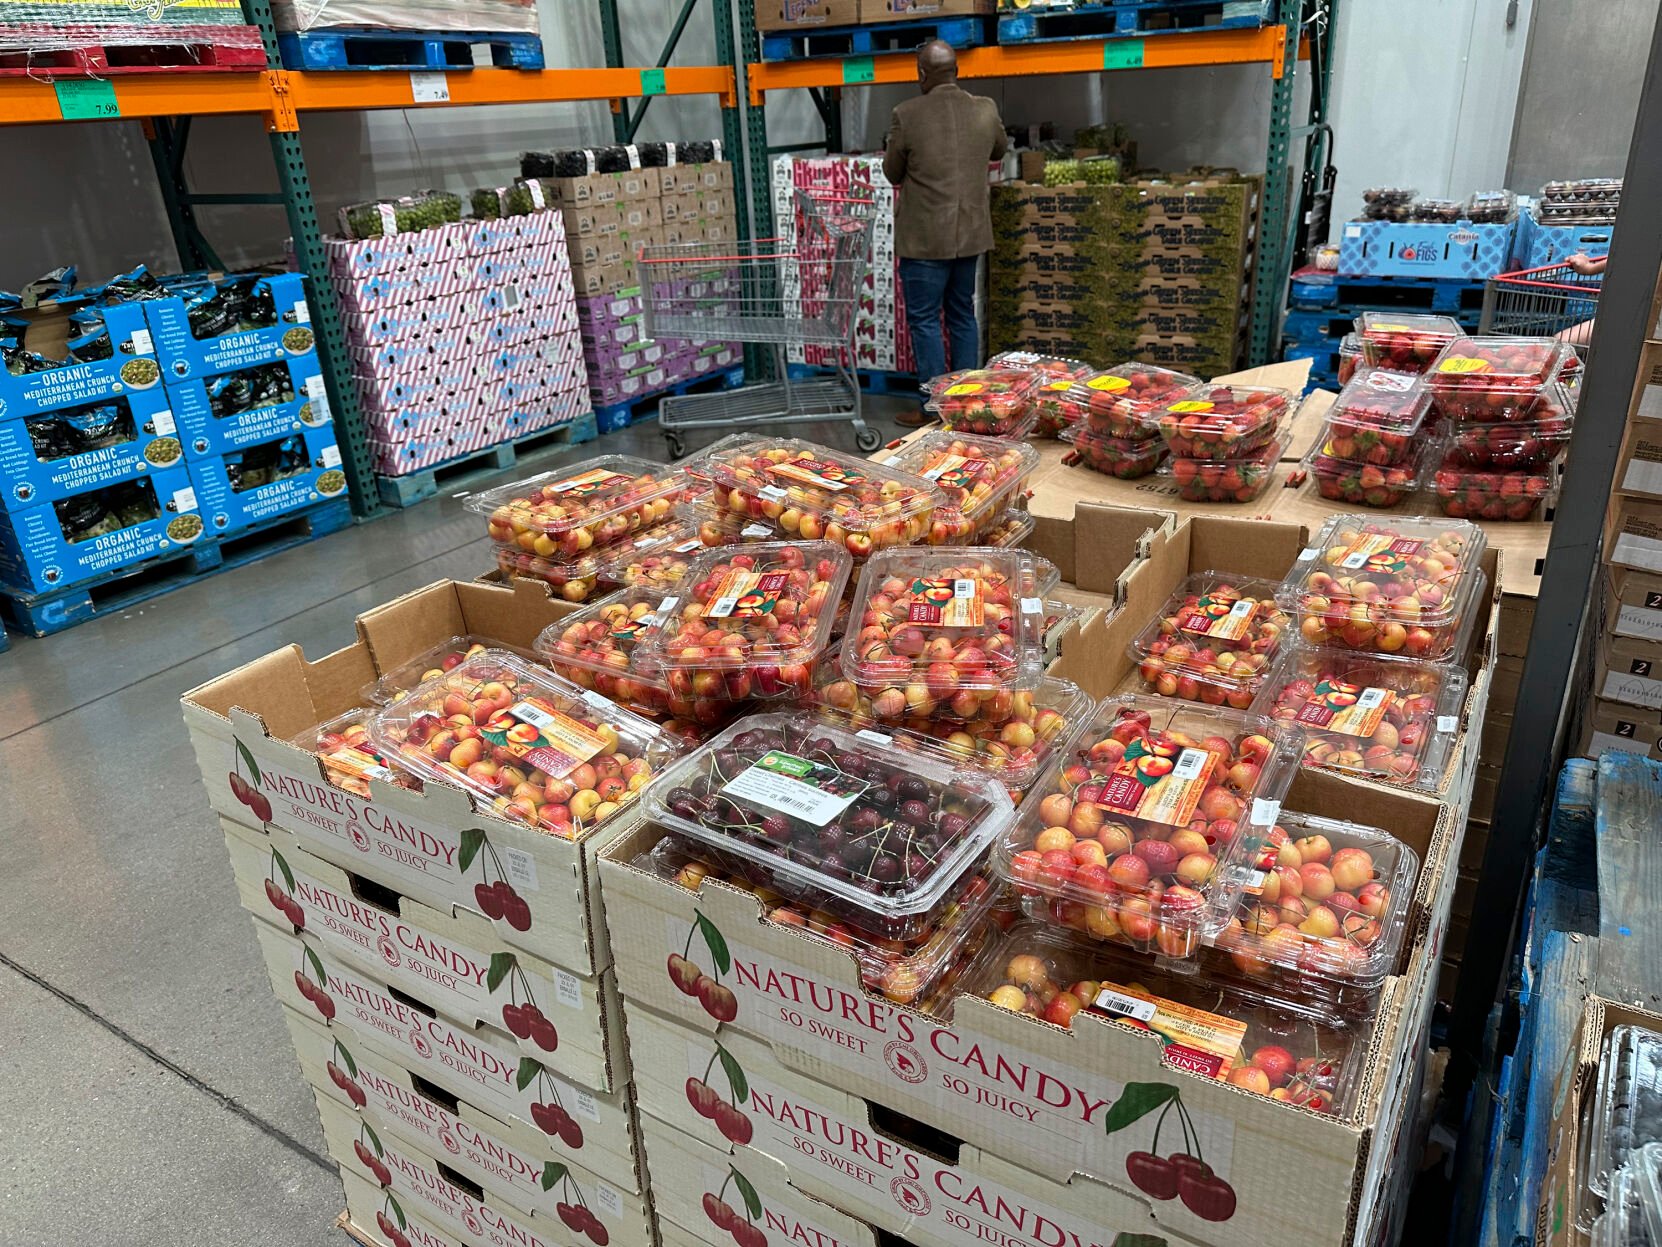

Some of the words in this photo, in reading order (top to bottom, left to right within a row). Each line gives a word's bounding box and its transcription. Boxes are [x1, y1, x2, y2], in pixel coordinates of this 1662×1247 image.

[96, 104, 117, 114] 7.99
[1416, 249, 1437, 261] FIGS
[204, 348, 254, 363] MEDITERRANEAN
[255, 342, 278, 354] CRUNCH
[220, 334, 260, 351] ORGANIC
[215, 359, 242, 369] CHOPPED
[244, 355, 263, 364] SALAD
[263, 351, 271, 360] KIT
[24, 381, 85, 400] MEDITERRANEAN
[88, 375, 115, 388] CRUNCH
[42, 366, 92, 386] ORGANIC
[38, 394, 71, 407] CHOPPED
[74, 390, 97, 400] SALAD
[98, 386, 107, 395] KIT
[224, 422, 272, 439] MEDITERRANEAN
[273, 415, 295, 427] CRUNCH
[238, 408, 278, 425] ORGANIC
[234, 433, 261, 444] CHOPPED
[262, 429, 281, 438] SALAD
[52, 462, 110, 484] MEDITERRANEAN
[113, 455, 139, 467] CRUNCH
[70, 448, 118, 469] ORGANIC
[64, 476, 97, 490] CHOPPED
[100, 470, 122, 481] SALAD
[122, 467, 131, 475] KIT
[256, 480, 295, 500] ORGANIC
[243, 494, 289, 513] MEDITERRANEAN
[291, 486, 312, 499] CRUNCH
[253, 506, 278, 518] CHOPPED
[280, 501, 298, 510] SALAD
[79, 543, 134, 565] MEDITERRANEAN
[136, 533, 162, 547] CRUNCH
[95, 528, 141, 550] ORGANIC
[91, 556, 122, 570] CHOPPED
[124, 549, 145, 560] SALAD
[145, 544, 155, 553] KIT
[1649, 595, 1662, 607] 2
[1635, 661, 1647, 674] 2
[1620, 724, 1631, 735] 2
[535, 751, 562, 768] CANDY
[1104, 776, 1122, 802] NATURE'S
[1111, 778, 1132, 805] CANDY
[261, 770, 360, 821] NATURE'S
[362, 807, 458, 866] CANDY
[291, 803, 307, 819] SO
[308, 808, 339, 834] SWEET
[377, 840, 393, 856] SO
[394, 846, 427, 871] JUICY
[295, 880, 390, 936] NATURE'S
[396, 927, 489, 986] CANDY
[323, 915, 338, 931] SO
[338, 920, 371, 947] SWEET
[408, 958, 423, 974] SO
[424, 964, 457, 989] JUICY
[326, 974, 424, 1031] NATURE'S
[427, 1023, 517, 1085] CANDY
[355, 1007, 370, 1020] SO
[371, 1013, 402, 1039] SWEET
[779, 1006, 805, 1026] SO
[807, 1015, 868, 1054] SWEET
[734, 957, 916, 1040] NATURE'S
[931, 1027, 1107, 1126] CANDY
[439, 1051, 454, 1066] SO
[455, 1057, 487, 1083] JUICY
[941, 1073, 973, 1095] SO
[975, 1085, 1040, 1123] JUICY
[358, 1068, 450, 1129] NATURE'S
[456, 1123, 542, 1184] CANDY
[385, 1100, 399, 1115] SO
[400, 1106, 431, 1133] SWEET
[751, 1087, 920, 1180] NATURE'S
[466, 1149, 481, 1163] SO
[482, 1155, 513, 1181] JUICY
[793, 1135, 815, 1156] SO
[818, 1146, 876, 1185] SWEET
[384, 1149, 473, 1213] NATURE'S
[410, 1181, 424, 1195] SO
[424, 1188, 455, 1215] SWEET
[945, 1208, 973, 1230] SO
[976, 1223, 1027, 1247] JUIC
